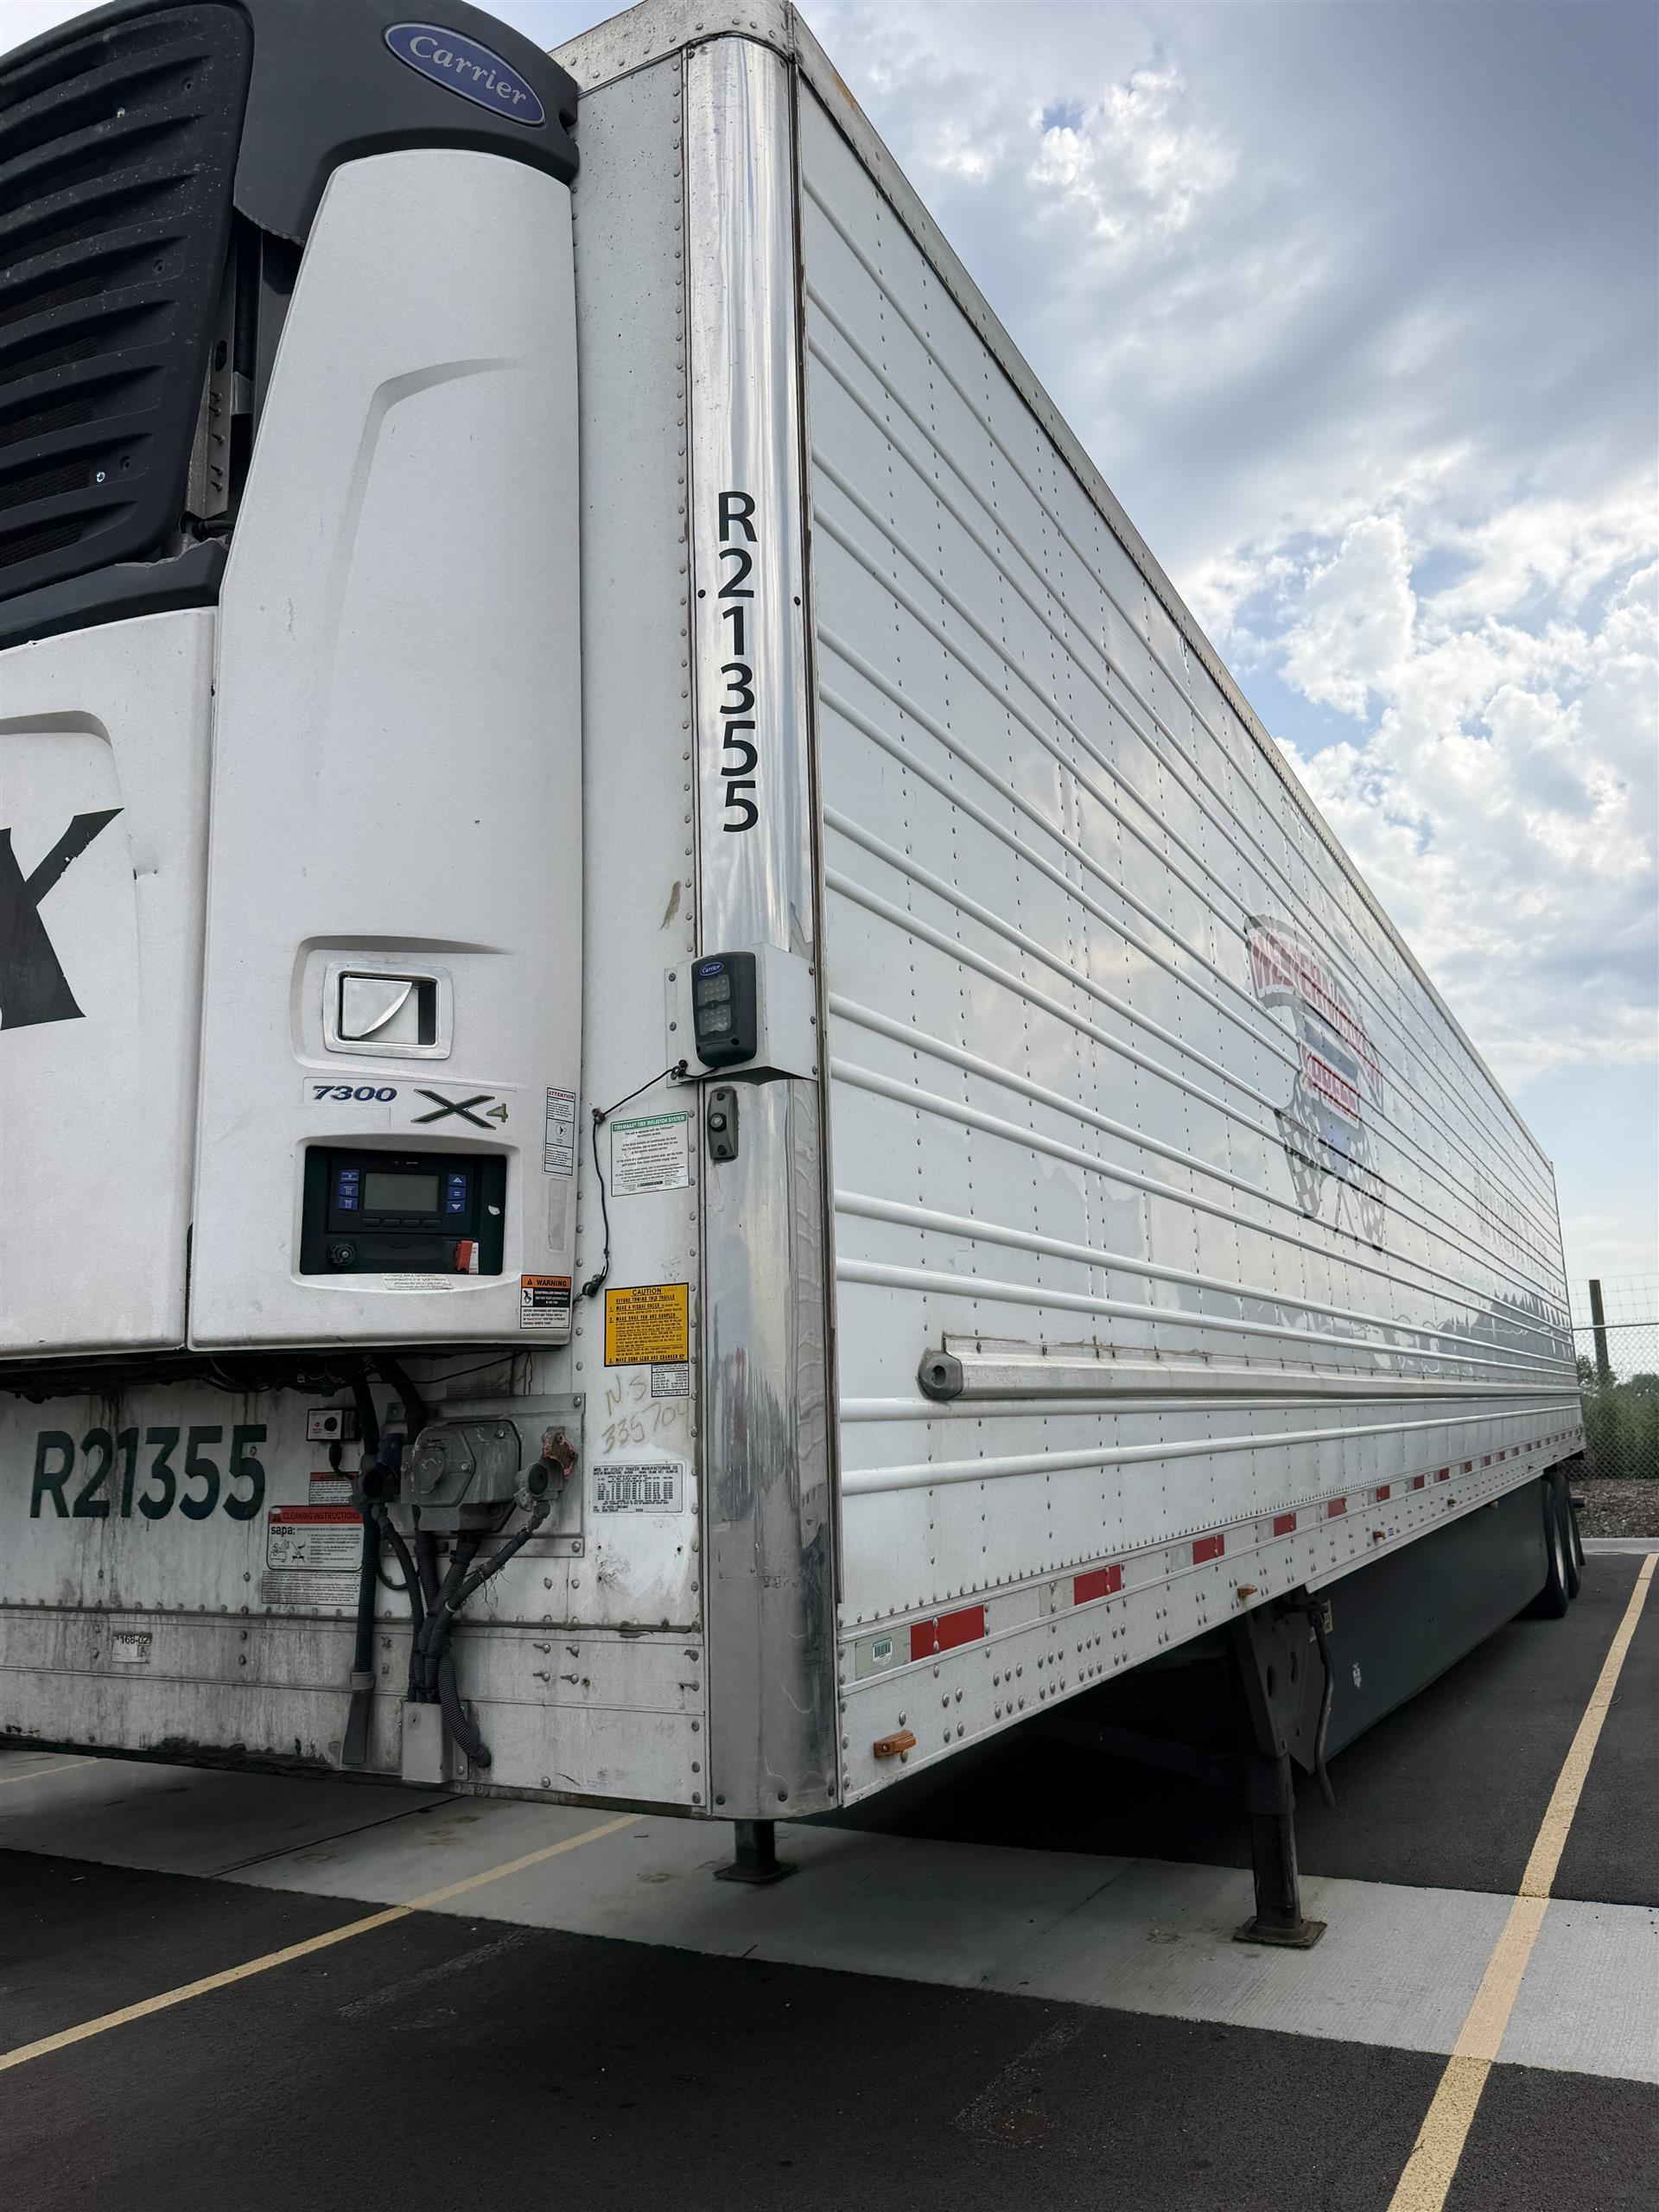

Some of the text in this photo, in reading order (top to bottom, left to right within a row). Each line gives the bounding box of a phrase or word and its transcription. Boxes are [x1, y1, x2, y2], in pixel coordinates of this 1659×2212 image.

[410, 36, 526, 105] Carrier
[718, 491, 759, 834] R21355
[312, 1085, 397, 1103] 7300
[549, 1090, 575, 1100] ATTENTION
[632, 1287, 662, 1296] CAUTION
[30, 1424, 267, 1521] R21355
